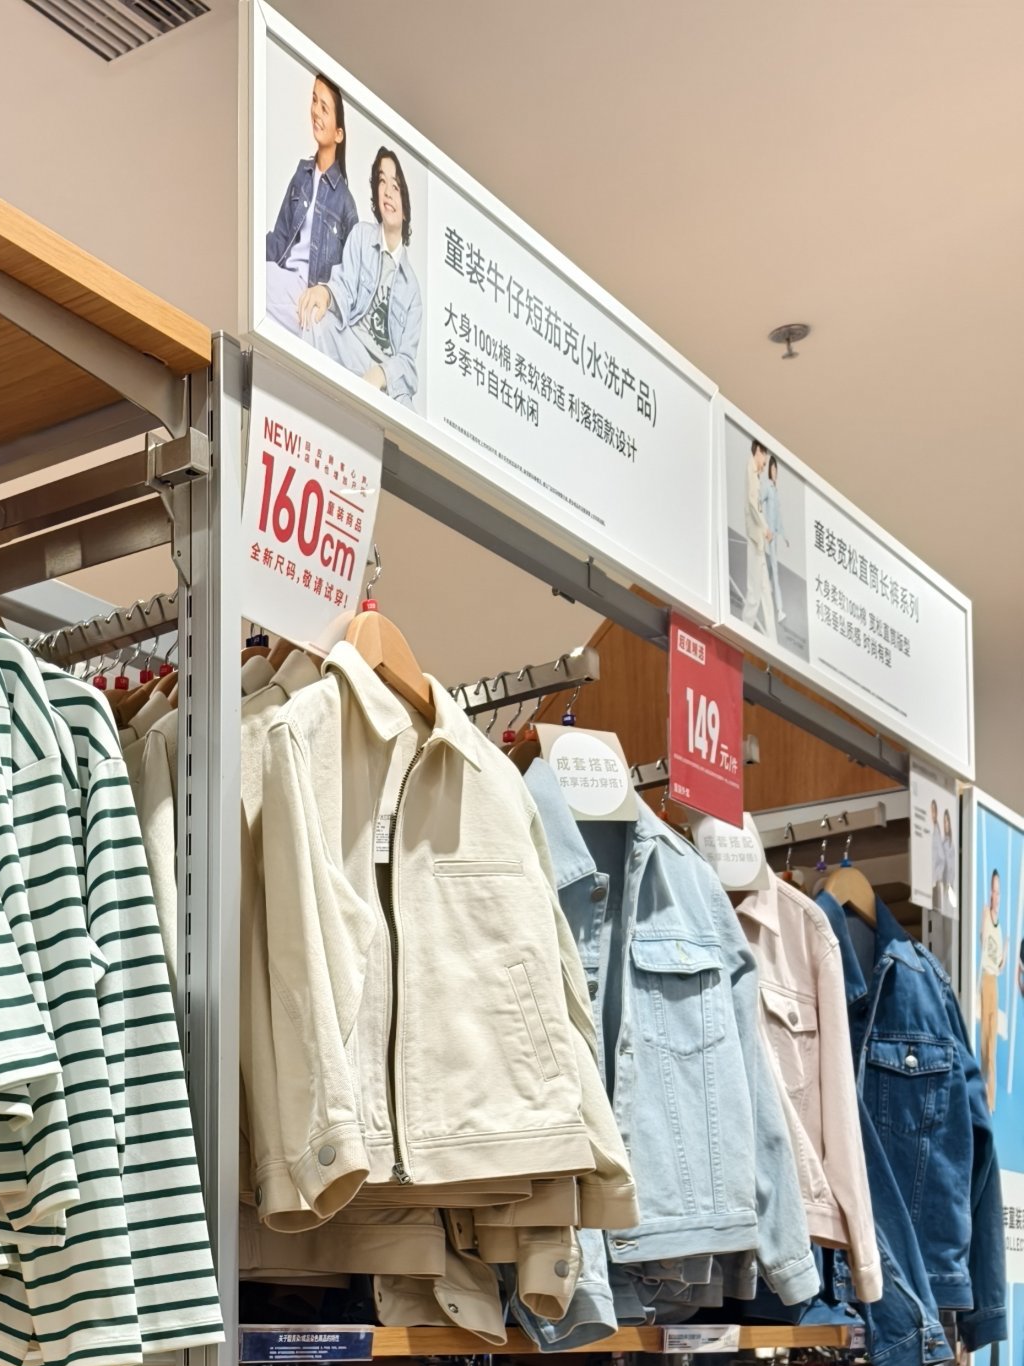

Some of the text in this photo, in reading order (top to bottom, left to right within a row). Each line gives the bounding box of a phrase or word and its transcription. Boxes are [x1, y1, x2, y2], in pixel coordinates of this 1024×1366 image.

[445, 302, 637, 463] 大身100%棉 柔软舒适 利落短款设计
[445, 339, 539, 427] 多季节自在休闲
[264, 416, 302, 458] NEW!
[326, 501, 362, 533] 童装商品
